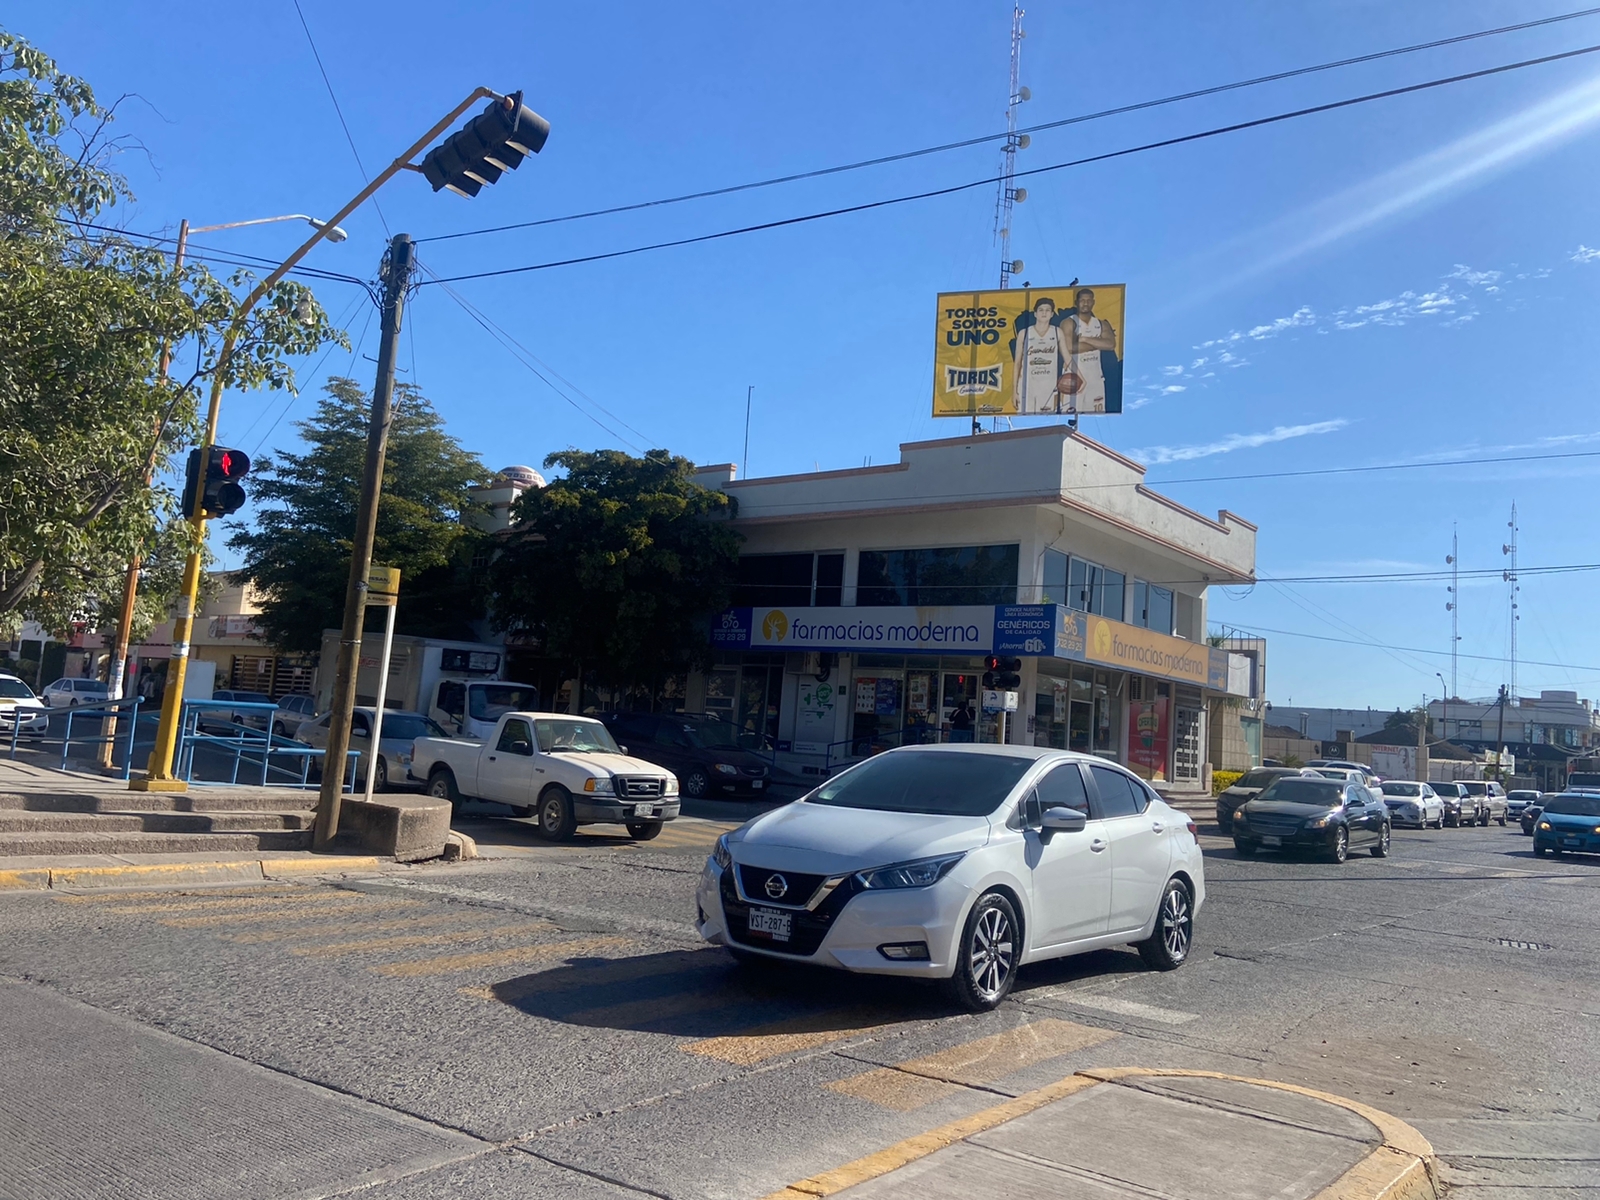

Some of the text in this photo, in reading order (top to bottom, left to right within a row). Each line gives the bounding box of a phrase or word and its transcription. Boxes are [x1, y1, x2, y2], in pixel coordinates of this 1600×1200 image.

[946, 307, 998, 319] TOROS
[952, 318, 1007, 329] SOMOS
[947, 329, 1000, 346] UNO
[949, 367, 999, 387] TOROS
[792, 618, 979, 642] farmacias moderna
[997, 619, 1051, 630] GENÉRICOS
[713, 633, 747, 641] 732 29 29
[1113, 633, 1164, 667] farmacias
[1165, 650, 1204, 676] moderna
